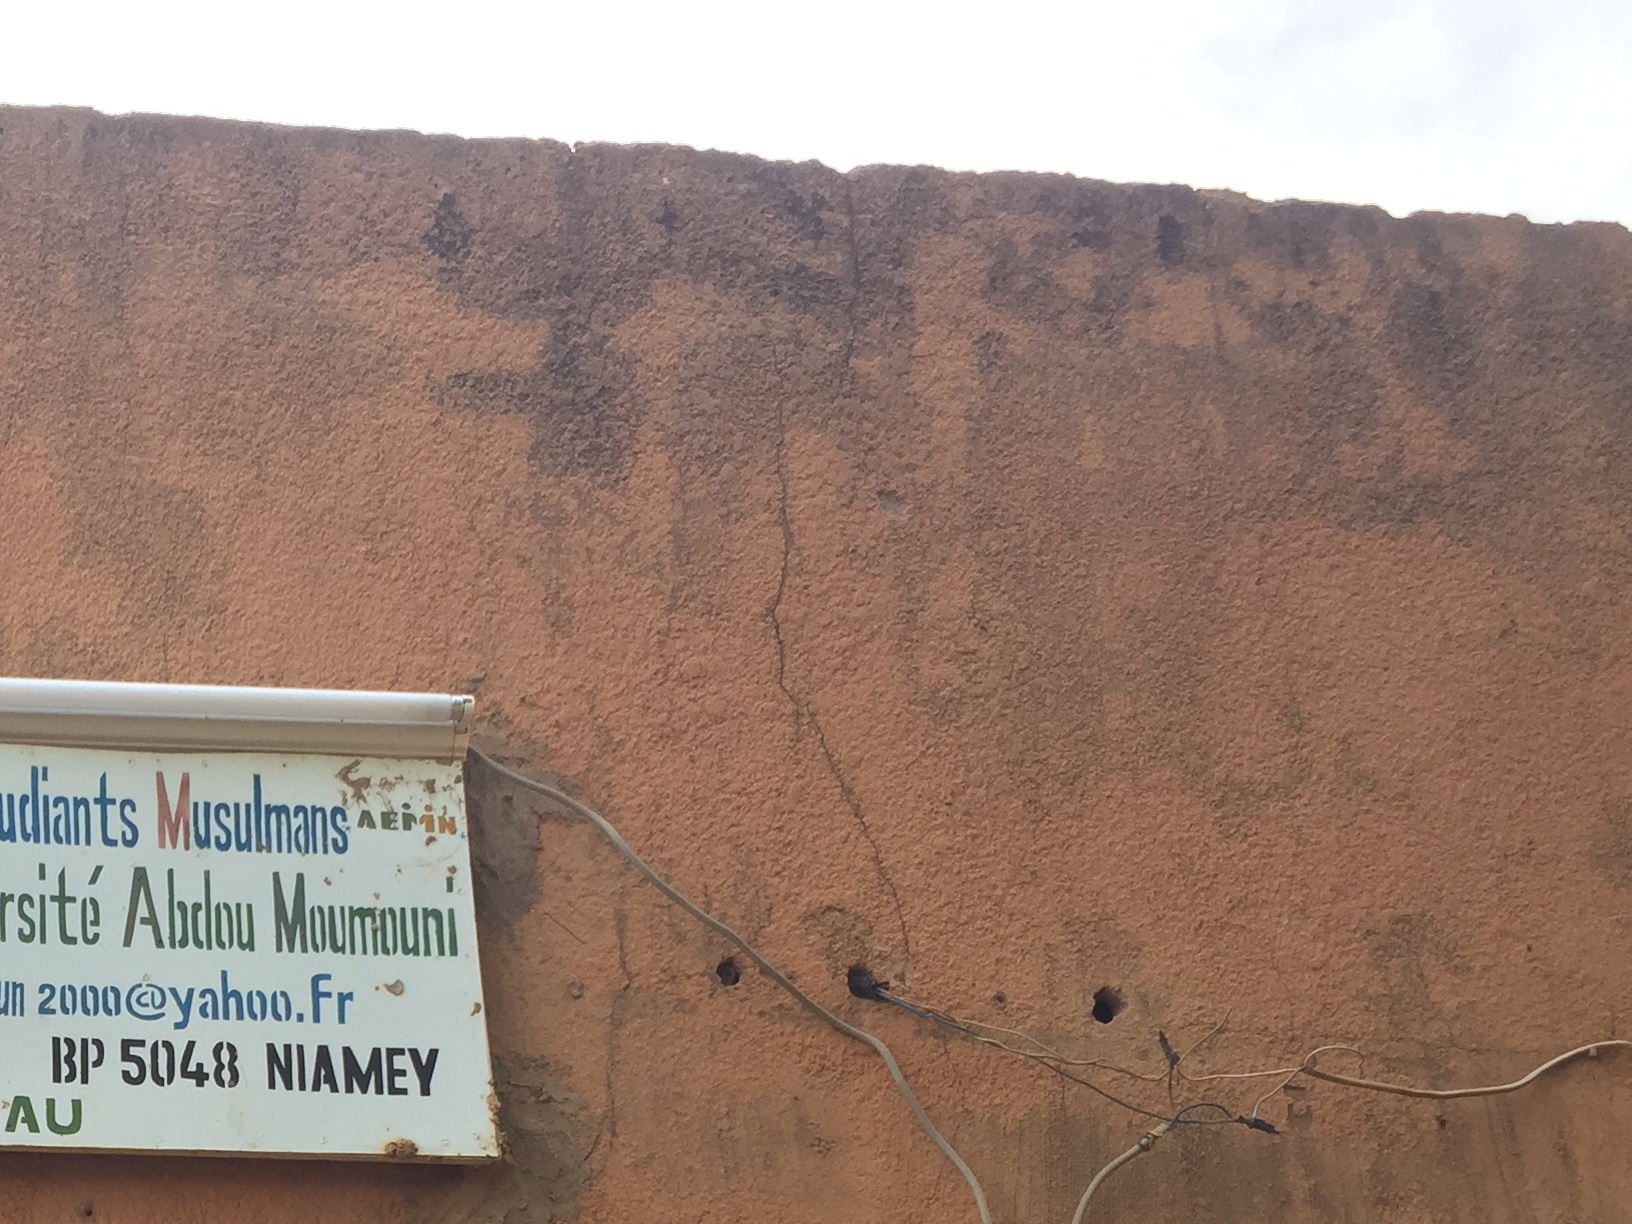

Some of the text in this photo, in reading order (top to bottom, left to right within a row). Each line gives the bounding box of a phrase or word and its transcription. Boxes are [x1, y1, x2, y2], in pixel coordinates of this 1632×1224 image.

[156, 771, 350, 855] Musulmans
[123, 866, 255, 952] Abdou
[272, 871, 458, 957] Moumouni
[37, 969, 354, 1030] 2000@yahoo.Fr
[51, 1036, 105, 1085] BP
[120, 1038, 240, 1088] 5048
[266, 1042, 440, 1097] NIAMEY
